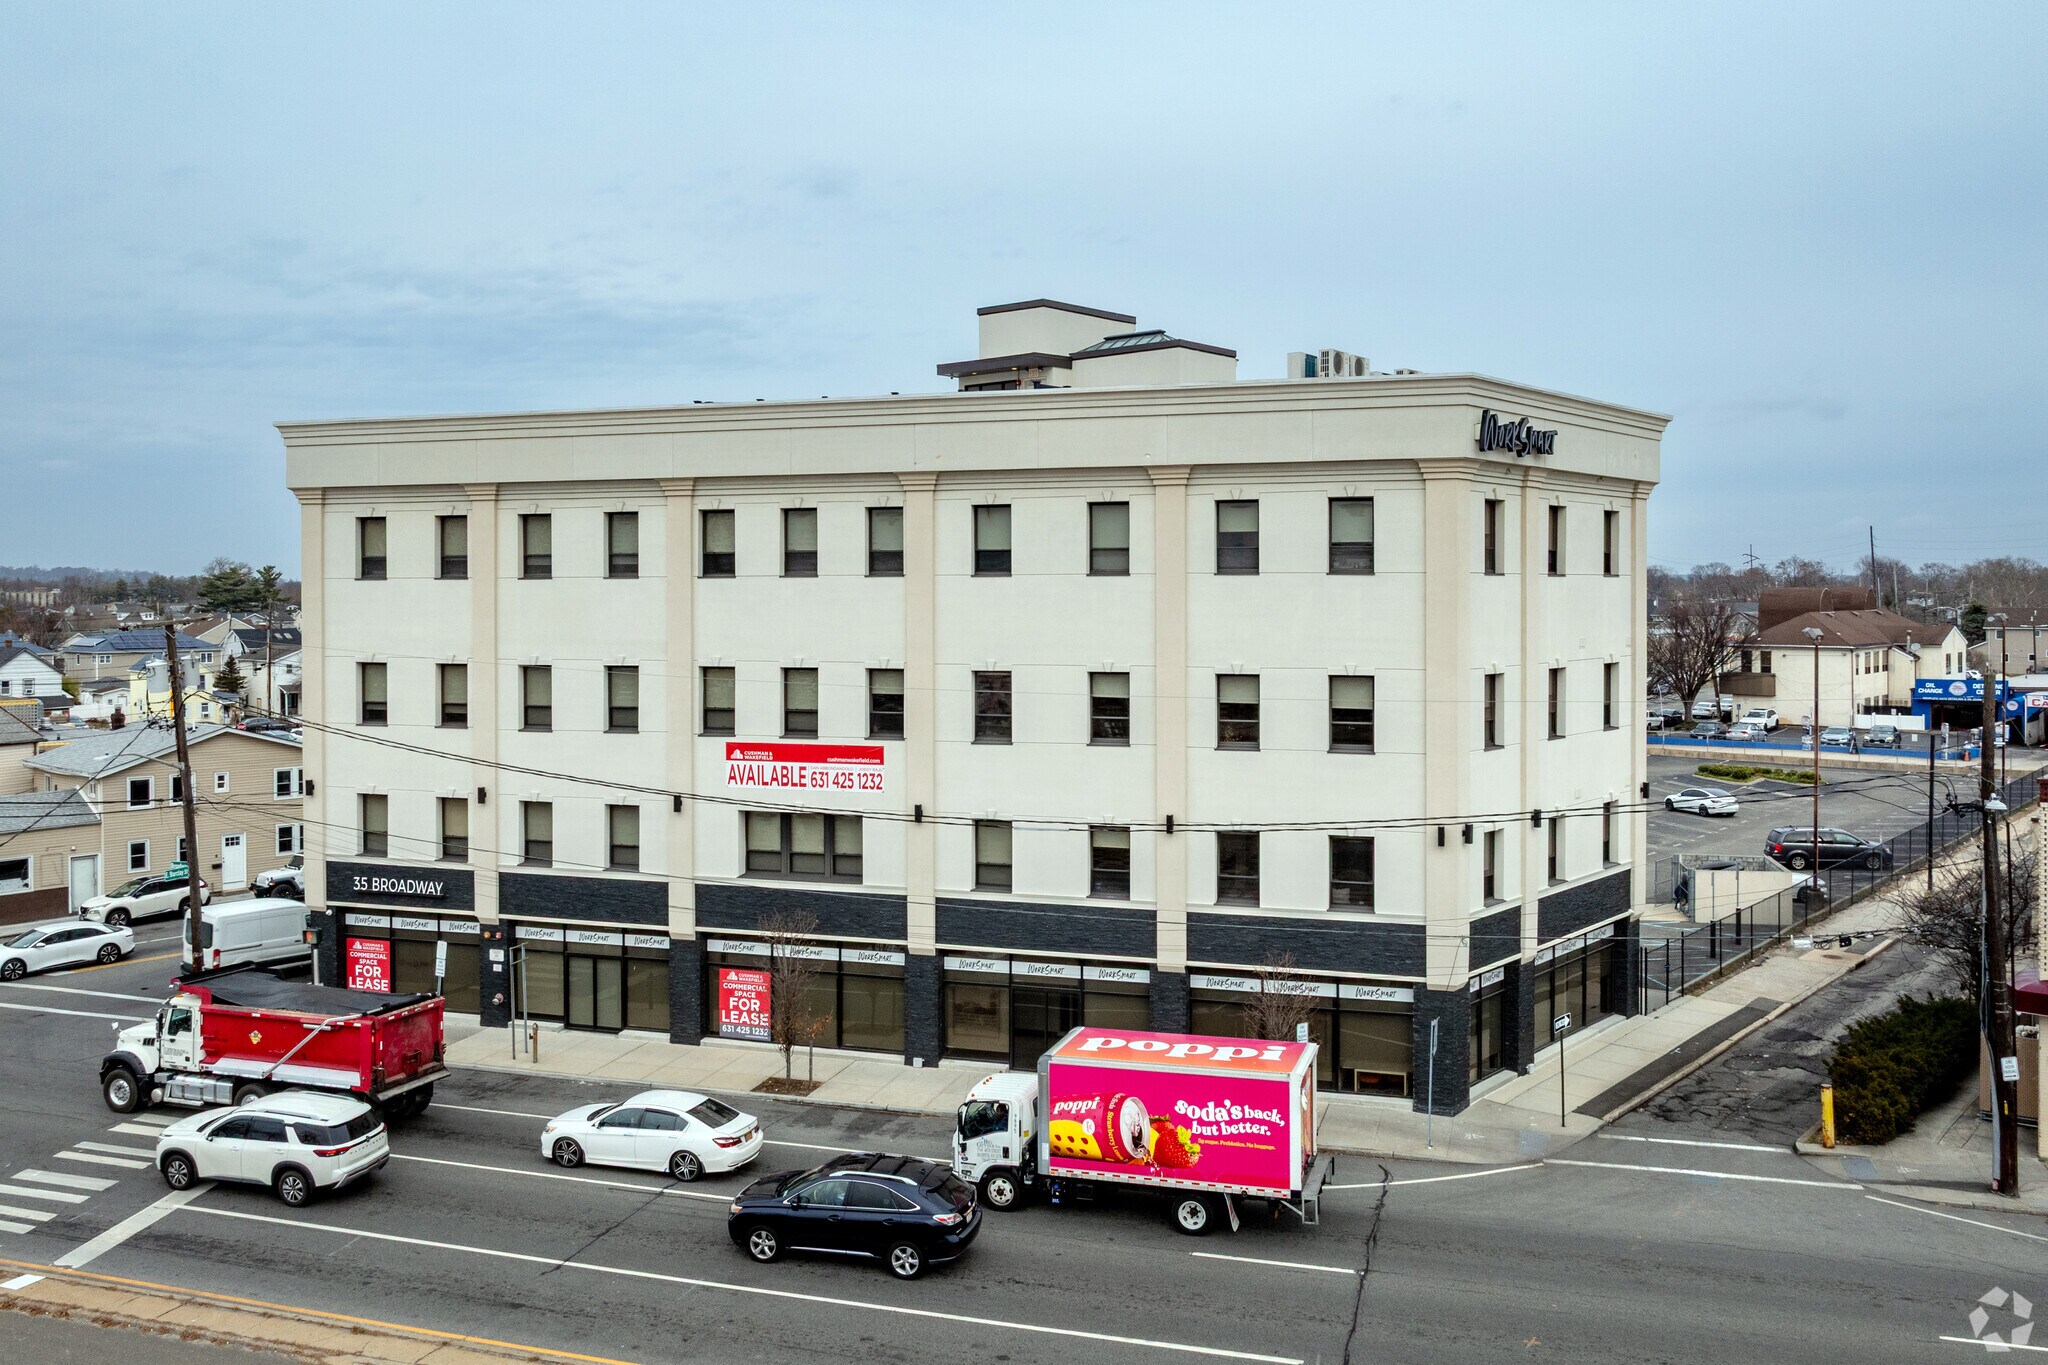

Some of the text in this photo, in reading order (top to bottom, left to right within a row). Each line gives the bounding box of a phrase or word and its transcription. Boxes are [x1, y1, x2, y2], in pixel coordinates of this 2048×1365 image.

[728, 764, 807, 788] AVAILABLE
[810, 771, 882, 790] 631 425 1232
[354, 876, 444, 895] 35 BROADWAY
[350, 952, 388, 960] COMMERCIAL
[355, 964, 382, 978] FOR
[348, 976, 389, 991] LEASE
[723, 982, 768, 992] COMMERCIAL
[730, 997, 760, 1012] FOR
[722, 1010, 768, 1026] LEASE
[722, 1024, 768, 1036] 631 425 1232
[1078, 1037, 1287, 1061] poppi
[1053, 1097, 1100, 1114] poppi
[1244, 1105, 1285, 1127] back,
[1192, 1121, 1271, 1136] but better.
